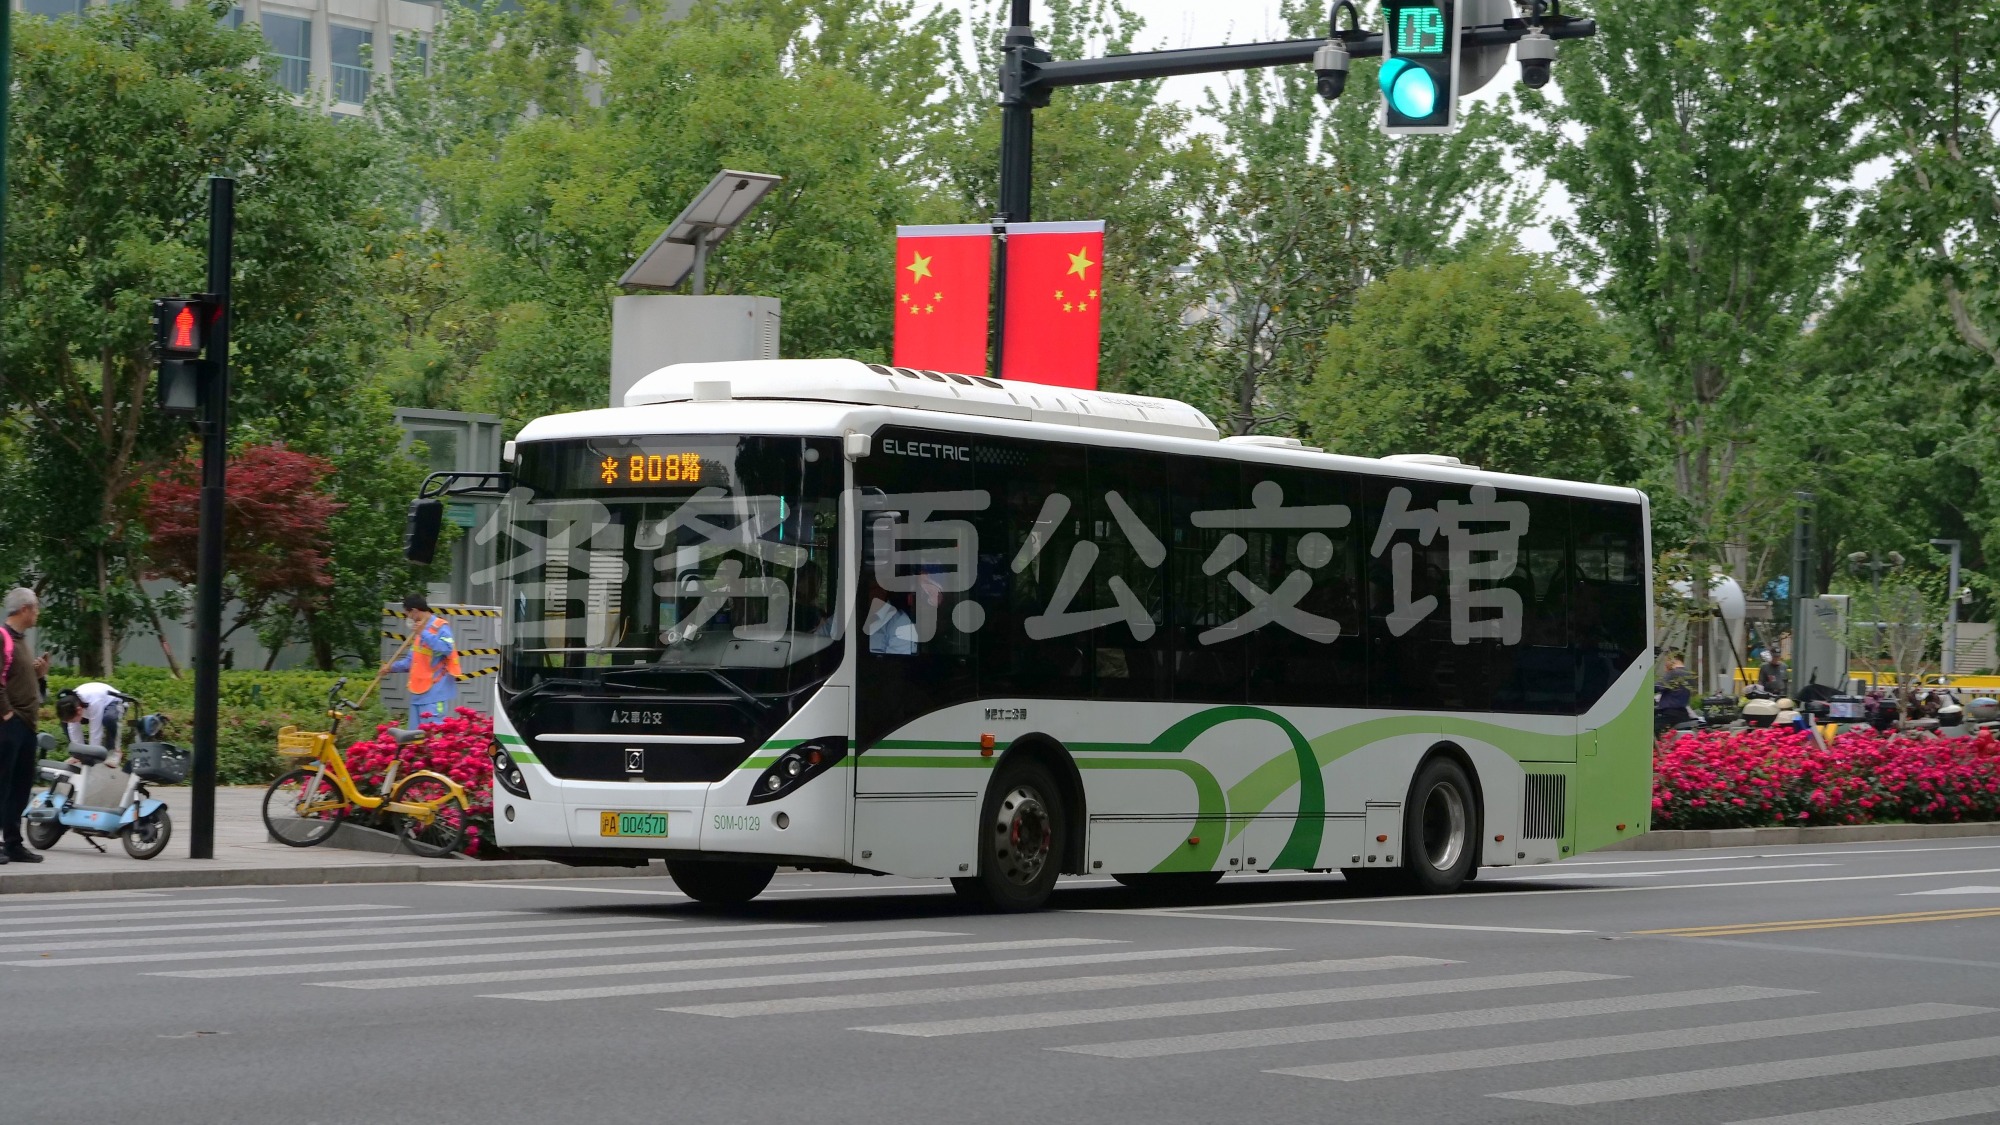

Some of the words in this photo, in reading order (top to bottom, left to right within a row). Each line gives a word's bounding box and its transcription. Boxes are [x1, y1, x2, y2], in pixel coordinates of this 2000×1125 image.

[1397, 7, 1444, 53] 09
[882, 438, 970, 462] ELECTRIC
[629, 452, 701, 482] 808路
[620, 710, 662, 725] 久事公交
[622, 816, 667, 834] 00457D
